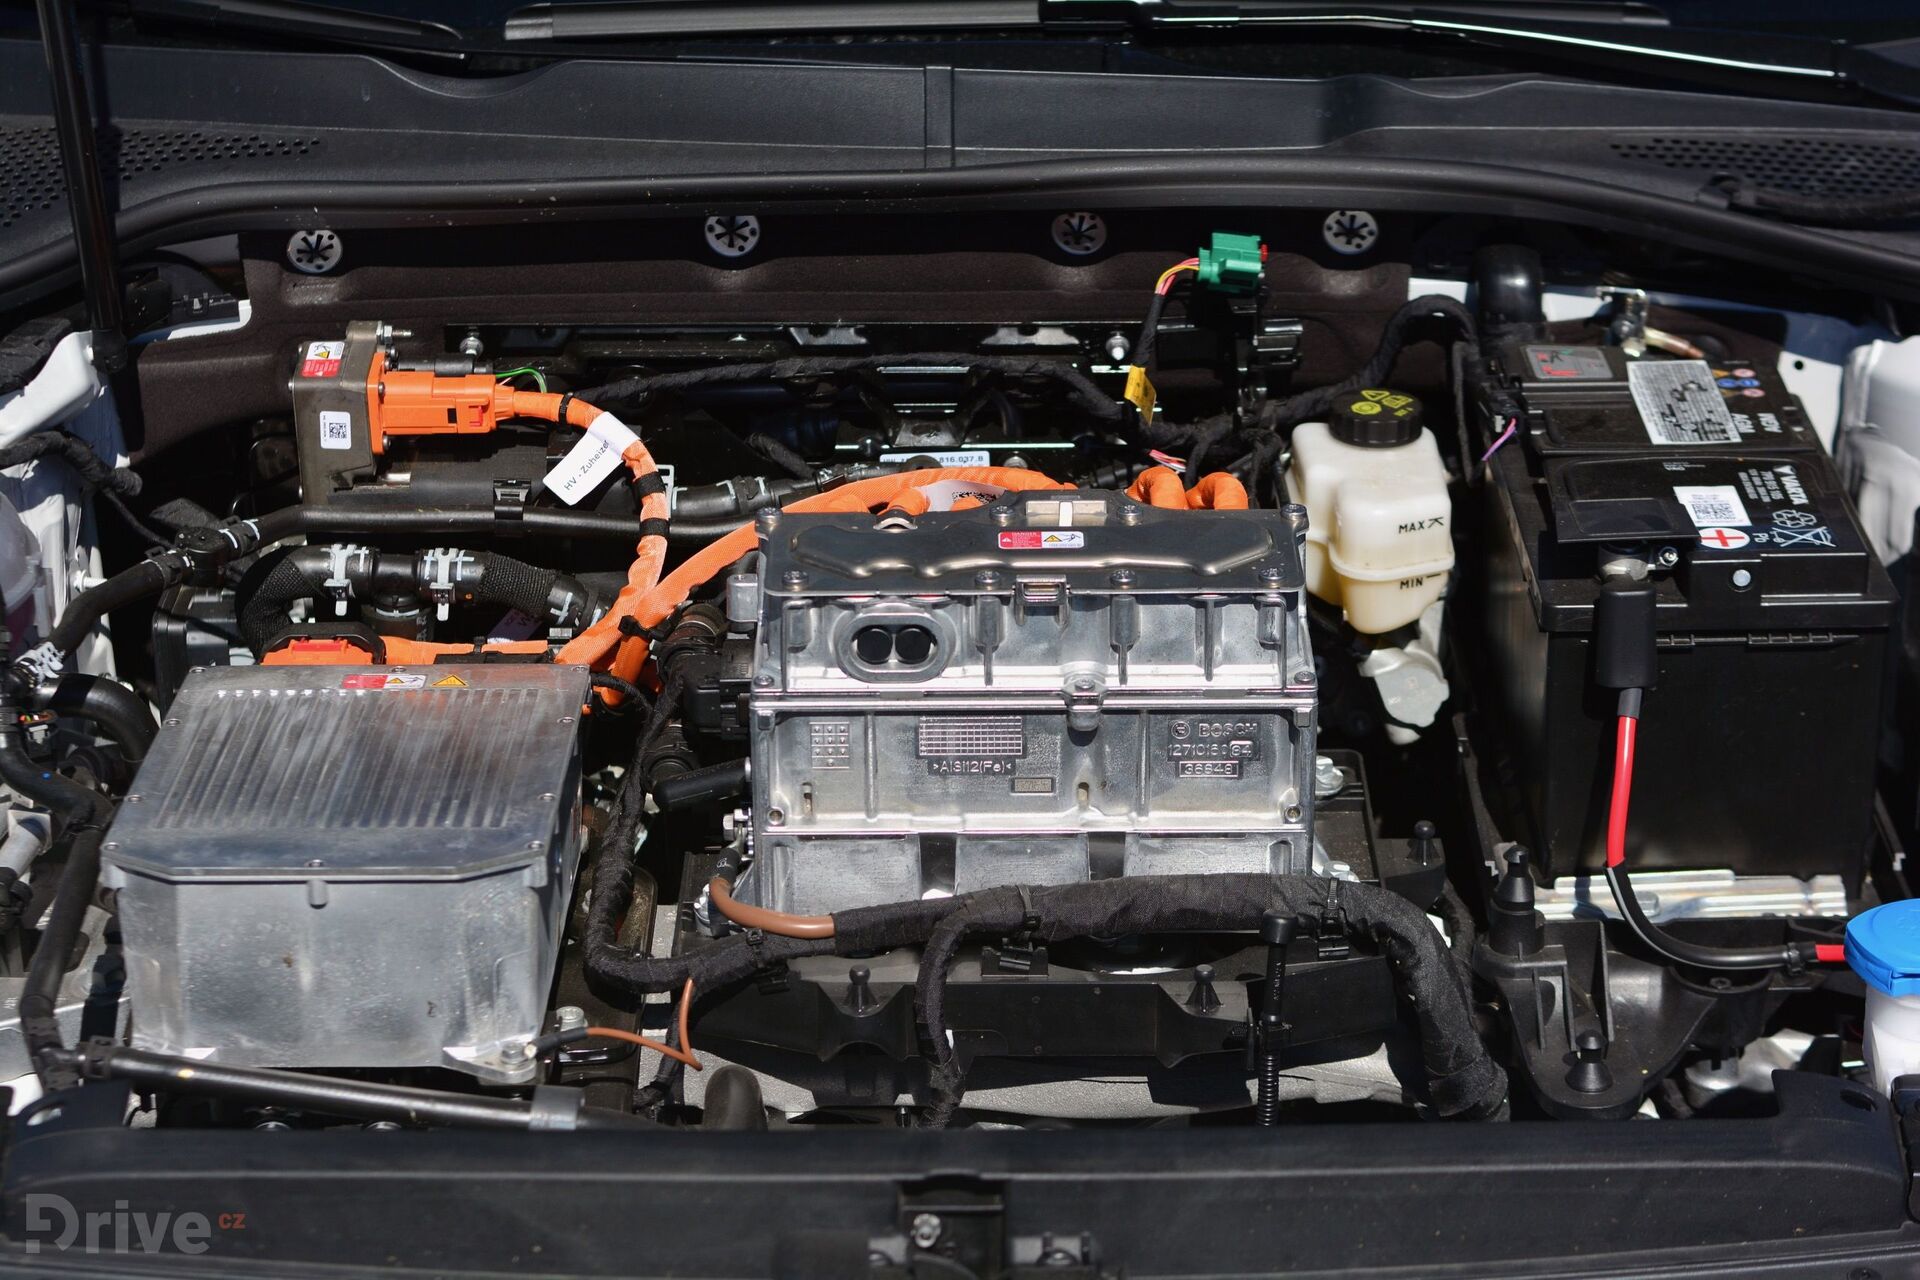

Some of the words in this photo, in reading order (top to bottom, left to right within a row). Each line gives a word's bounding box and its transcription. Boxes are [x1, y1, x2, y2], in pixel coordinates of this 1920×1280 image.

[563, 477, 577, 491] HV
[580, 440, 610, 474] Zuheizer
[1779, 475, 1809, 505] VARTA
[1399, 521, 1425, 534] MAX
[1752, 533, 1770, 543] Pb
[1400, 577, 1423, 589] MIN
[1199, 723, 1258, 737] BOSCH
